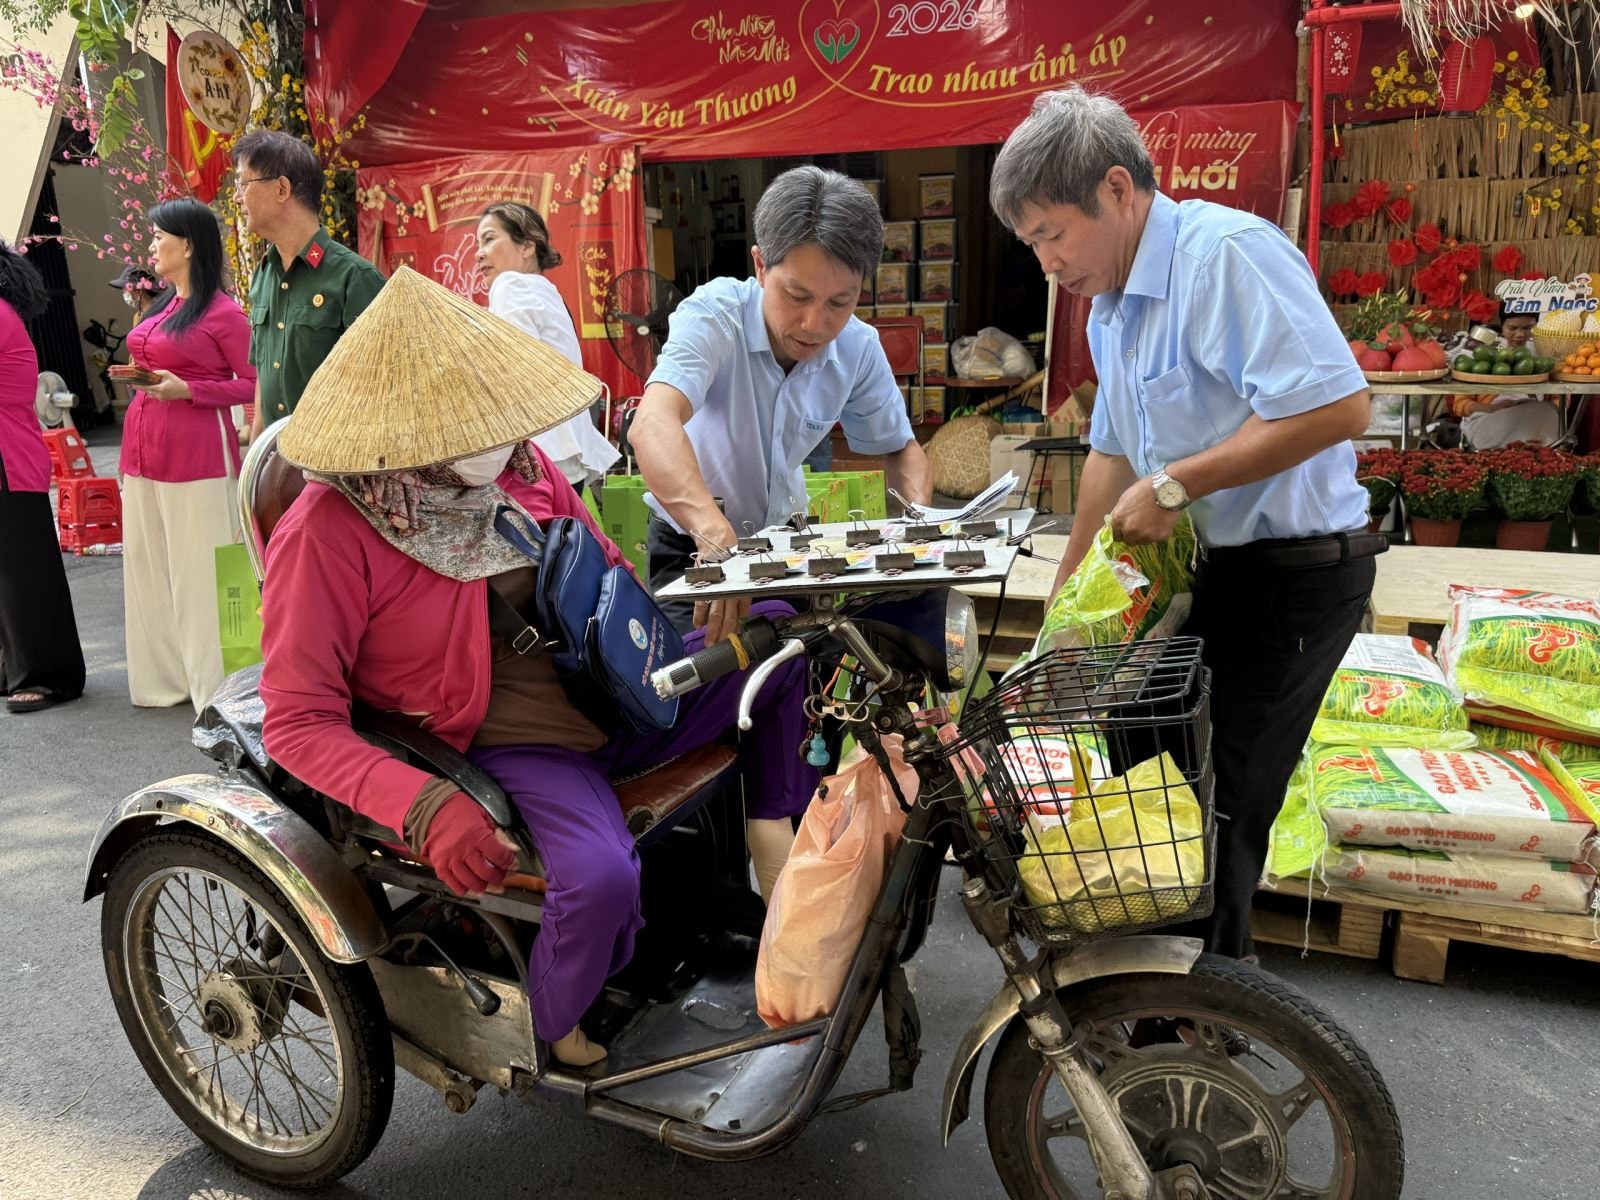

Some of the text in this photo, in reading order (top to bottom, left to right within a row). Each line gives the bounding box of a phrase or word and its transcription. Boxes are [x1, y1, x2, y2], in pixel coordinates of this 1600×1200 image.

[691, 9, 776, 44] Chúc Mừng
[886, 0, 978, 37] 2026
[868, 33, 1128, 94] Trao nhau ấm áp
[564, 72, 797, 128] Xuân Yêu Thương
[1138, 111, 1257, 169] húc mừng
[1170, 159, 1239, 190] MỚI
[1495, 280, 1527, 299] Trái
[1504, 296, 1542, 312] Tâm
[1443, 752, 1484, 792] MEKONG
[1446, 829, 1497, 842] MEKONG
[1448, 878, 1498, 891] MEKONG
